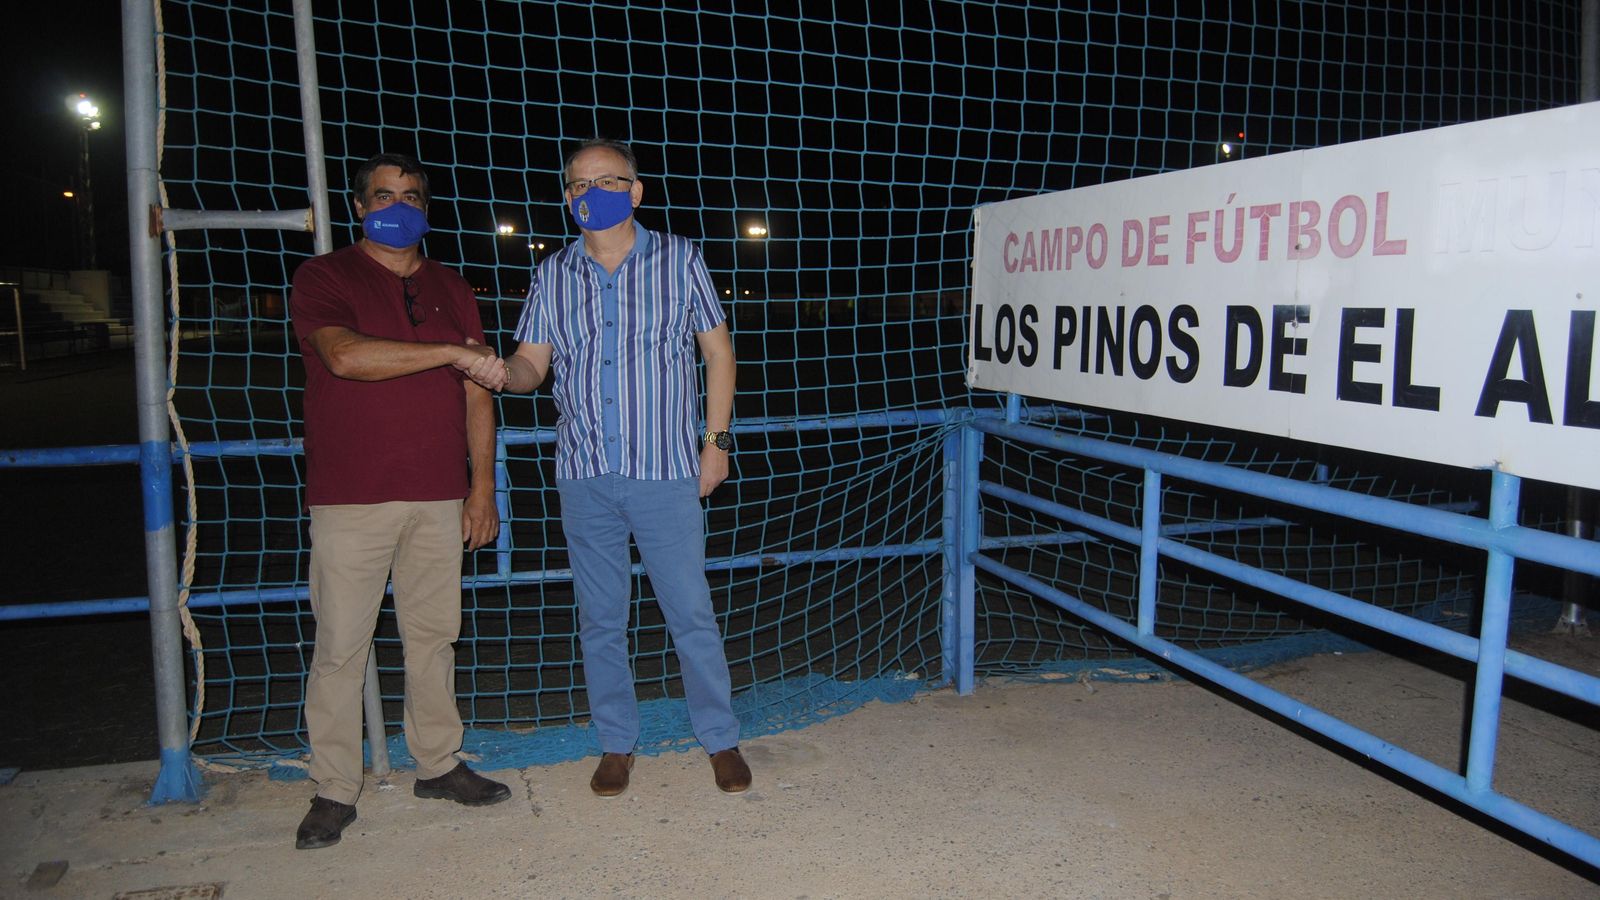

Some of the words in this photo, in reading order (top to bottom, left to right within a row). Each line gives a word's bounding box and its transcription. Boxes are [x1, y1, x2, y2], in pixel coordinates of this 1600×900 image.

[1003, 222, 1108, 274] CAMPO
[1121, 214, 1170, 268] DE
[1186, 191, 1408, 265] FÚTBOL
[974, 303, 1039, 368] LOS
[1053, 304, 1200, 384] PINOS
[1223, 304, 1311, 395] DE
[1336, 307, 1441, 412] EL
[1474, 309, 1600, 430] AL
